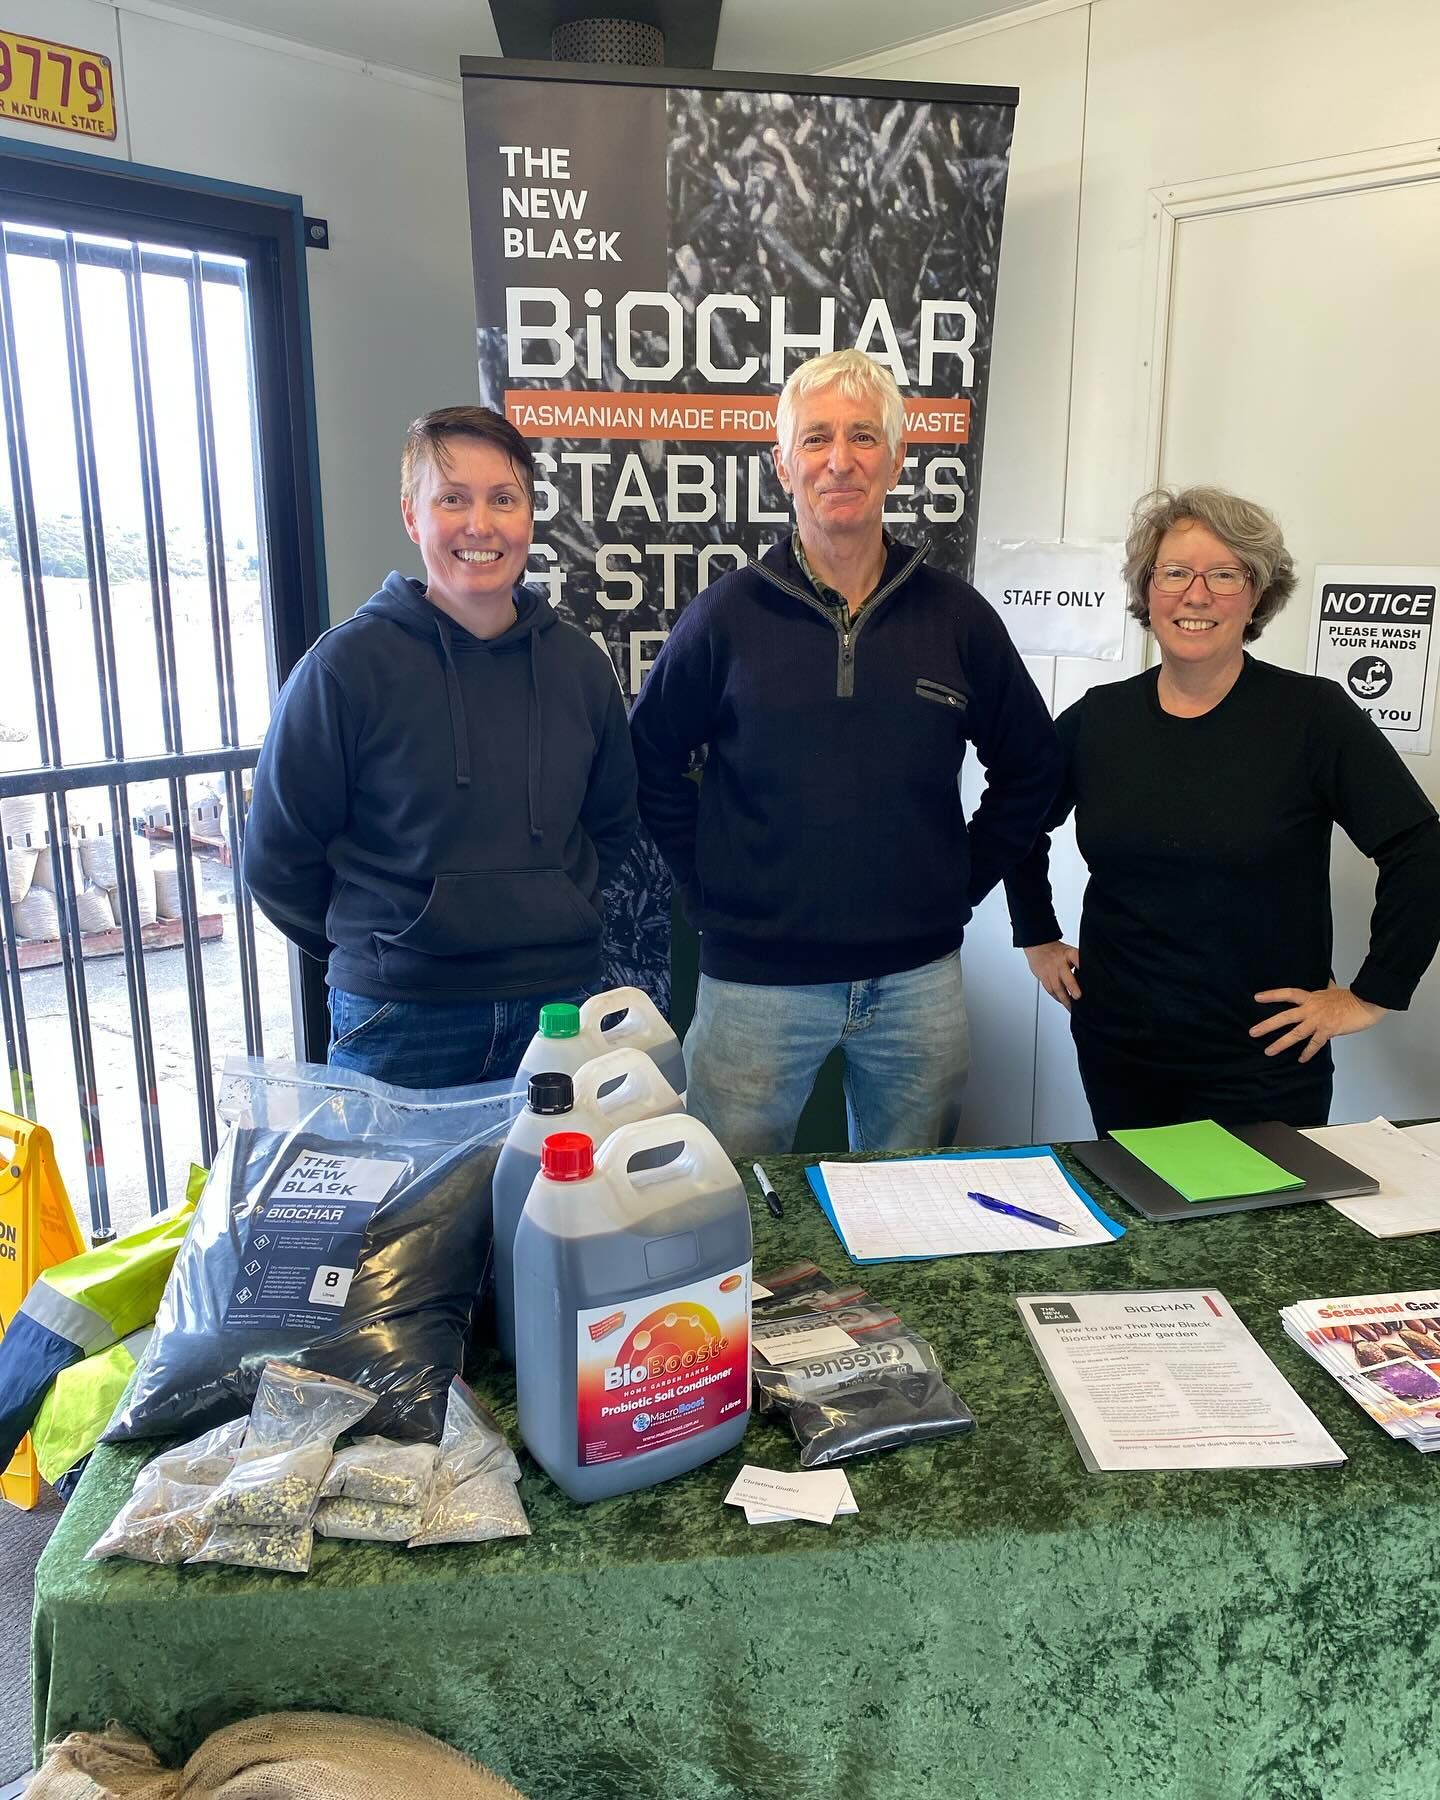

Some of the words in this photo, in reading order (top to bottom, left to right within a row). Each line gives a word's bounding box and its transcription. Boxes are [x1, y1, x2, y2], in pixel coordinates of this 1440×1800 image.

[11, 101, 66, 125] NATURAL
[71, 114, 105, 133] STATE
[499, 146, 571, 180] THE
[502, 187, 588, 220] NEW
[503, 227, 623, 262] BLACK
[511, 404, 643, 428] TASMANIAN
[650, 407, 714, 430] MADE
[1003, 589, 1052, 606] STAFF
[1057, 591, 1105, 607] ONLY
[1323, 592, 1432, 616] NOTICE
[1329, 626, 1378, 637] PLEASE
[1382, 628, 1421, 639] WASH
[1331, 638, 1367, 648] YOUR
[1371, 640, 1417, 650] HANDS
[1378, 709, 1412, 721] YOU
[303, 1156, 346, 1169] THE
[290, 1168, 349, 1180] NEW
[281, 1181, 358, 1196] BLACK
[266, 1208, 344, 1221] BIOCHAR
[324, 1272, 340, 1287] 8
[1317, 1303, 1405, 1319] Seasonal
[1405, 1302, 1440, 1311] Gar
[1056, 1327, 1082, 1335] How
[1060, 1333, 1107, 1343] Biochar
[1110, 1332, 1122, 1340] in
[1124, 1332, 1152, 1340] your
[1155, 1330, 1199, 1339] garden
[624, 1386, 647, 1398] HOME
[650, 1376, 682, 1390] GARDEN
[685, 1365, 709, 1379] RANGE
[601, 1396, 653, 1417] Probiotic
[654, 1388, 675, 1403] Soil
[676, 1367, 733, 1396] Conditioner
[650, 1397, 705, 1422] MacroBoost
[720, 1406, 725, 1414] 4
[725, 1398, 742, 1411] Litres
